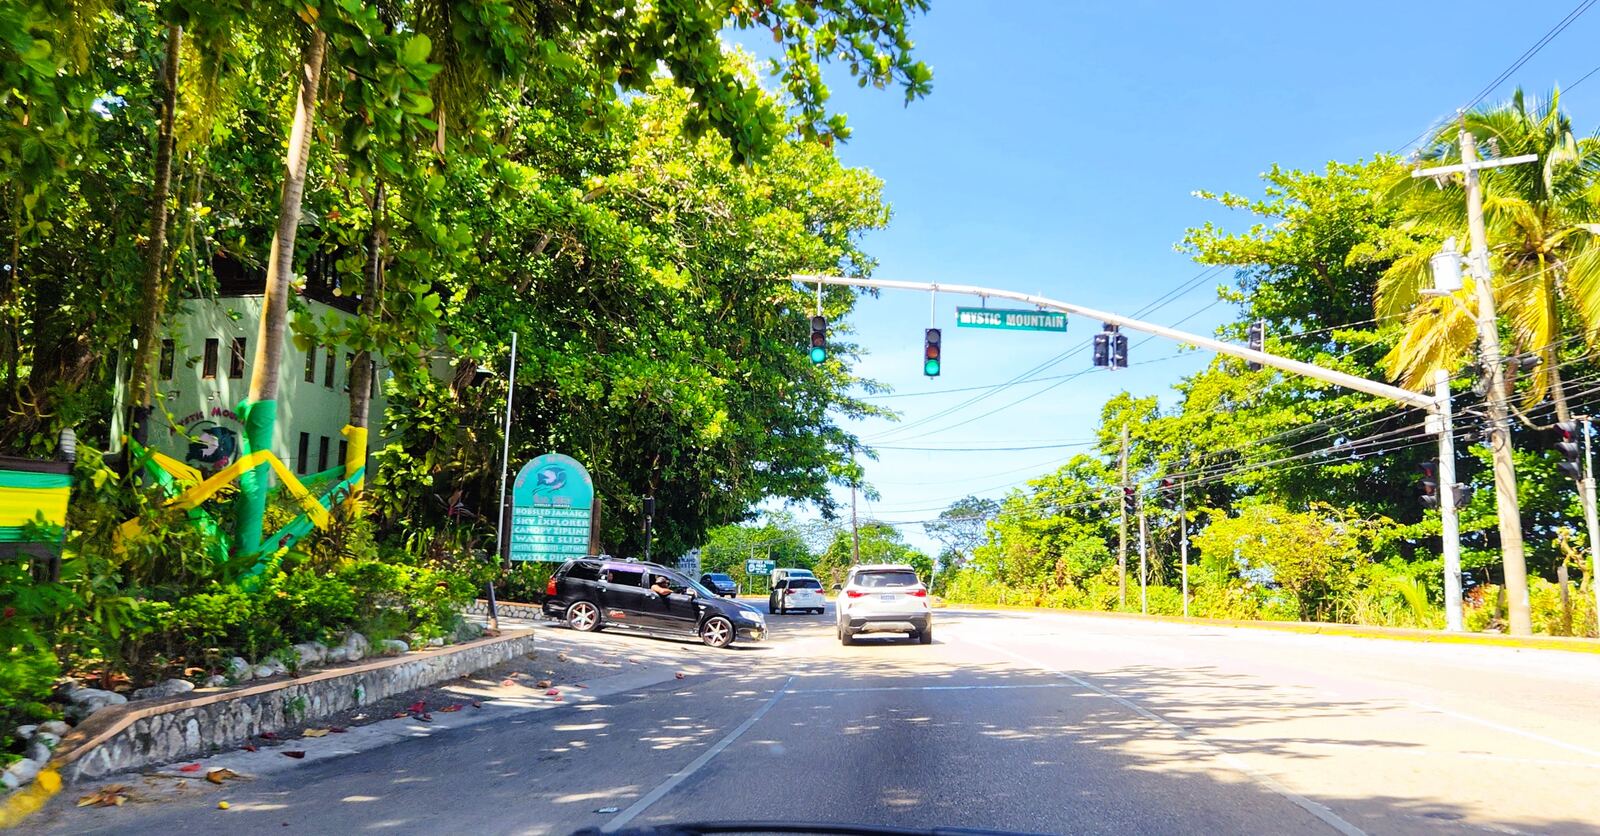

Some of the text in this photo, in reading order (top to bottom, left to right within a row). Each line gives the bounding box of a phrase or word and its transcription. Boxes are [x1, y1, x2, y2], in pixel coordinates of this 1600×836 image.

[960, 312, 1065, 328] MYSTIC MOUNTAIN
[552, 509, 589, 517] JAMAICA
[516, 517, 589, 527] SKY EXPLORER
[514, 526, 589, 536] CANOPY ZIPLINE
[515, 535, 589, 544] WATER SLIDE
